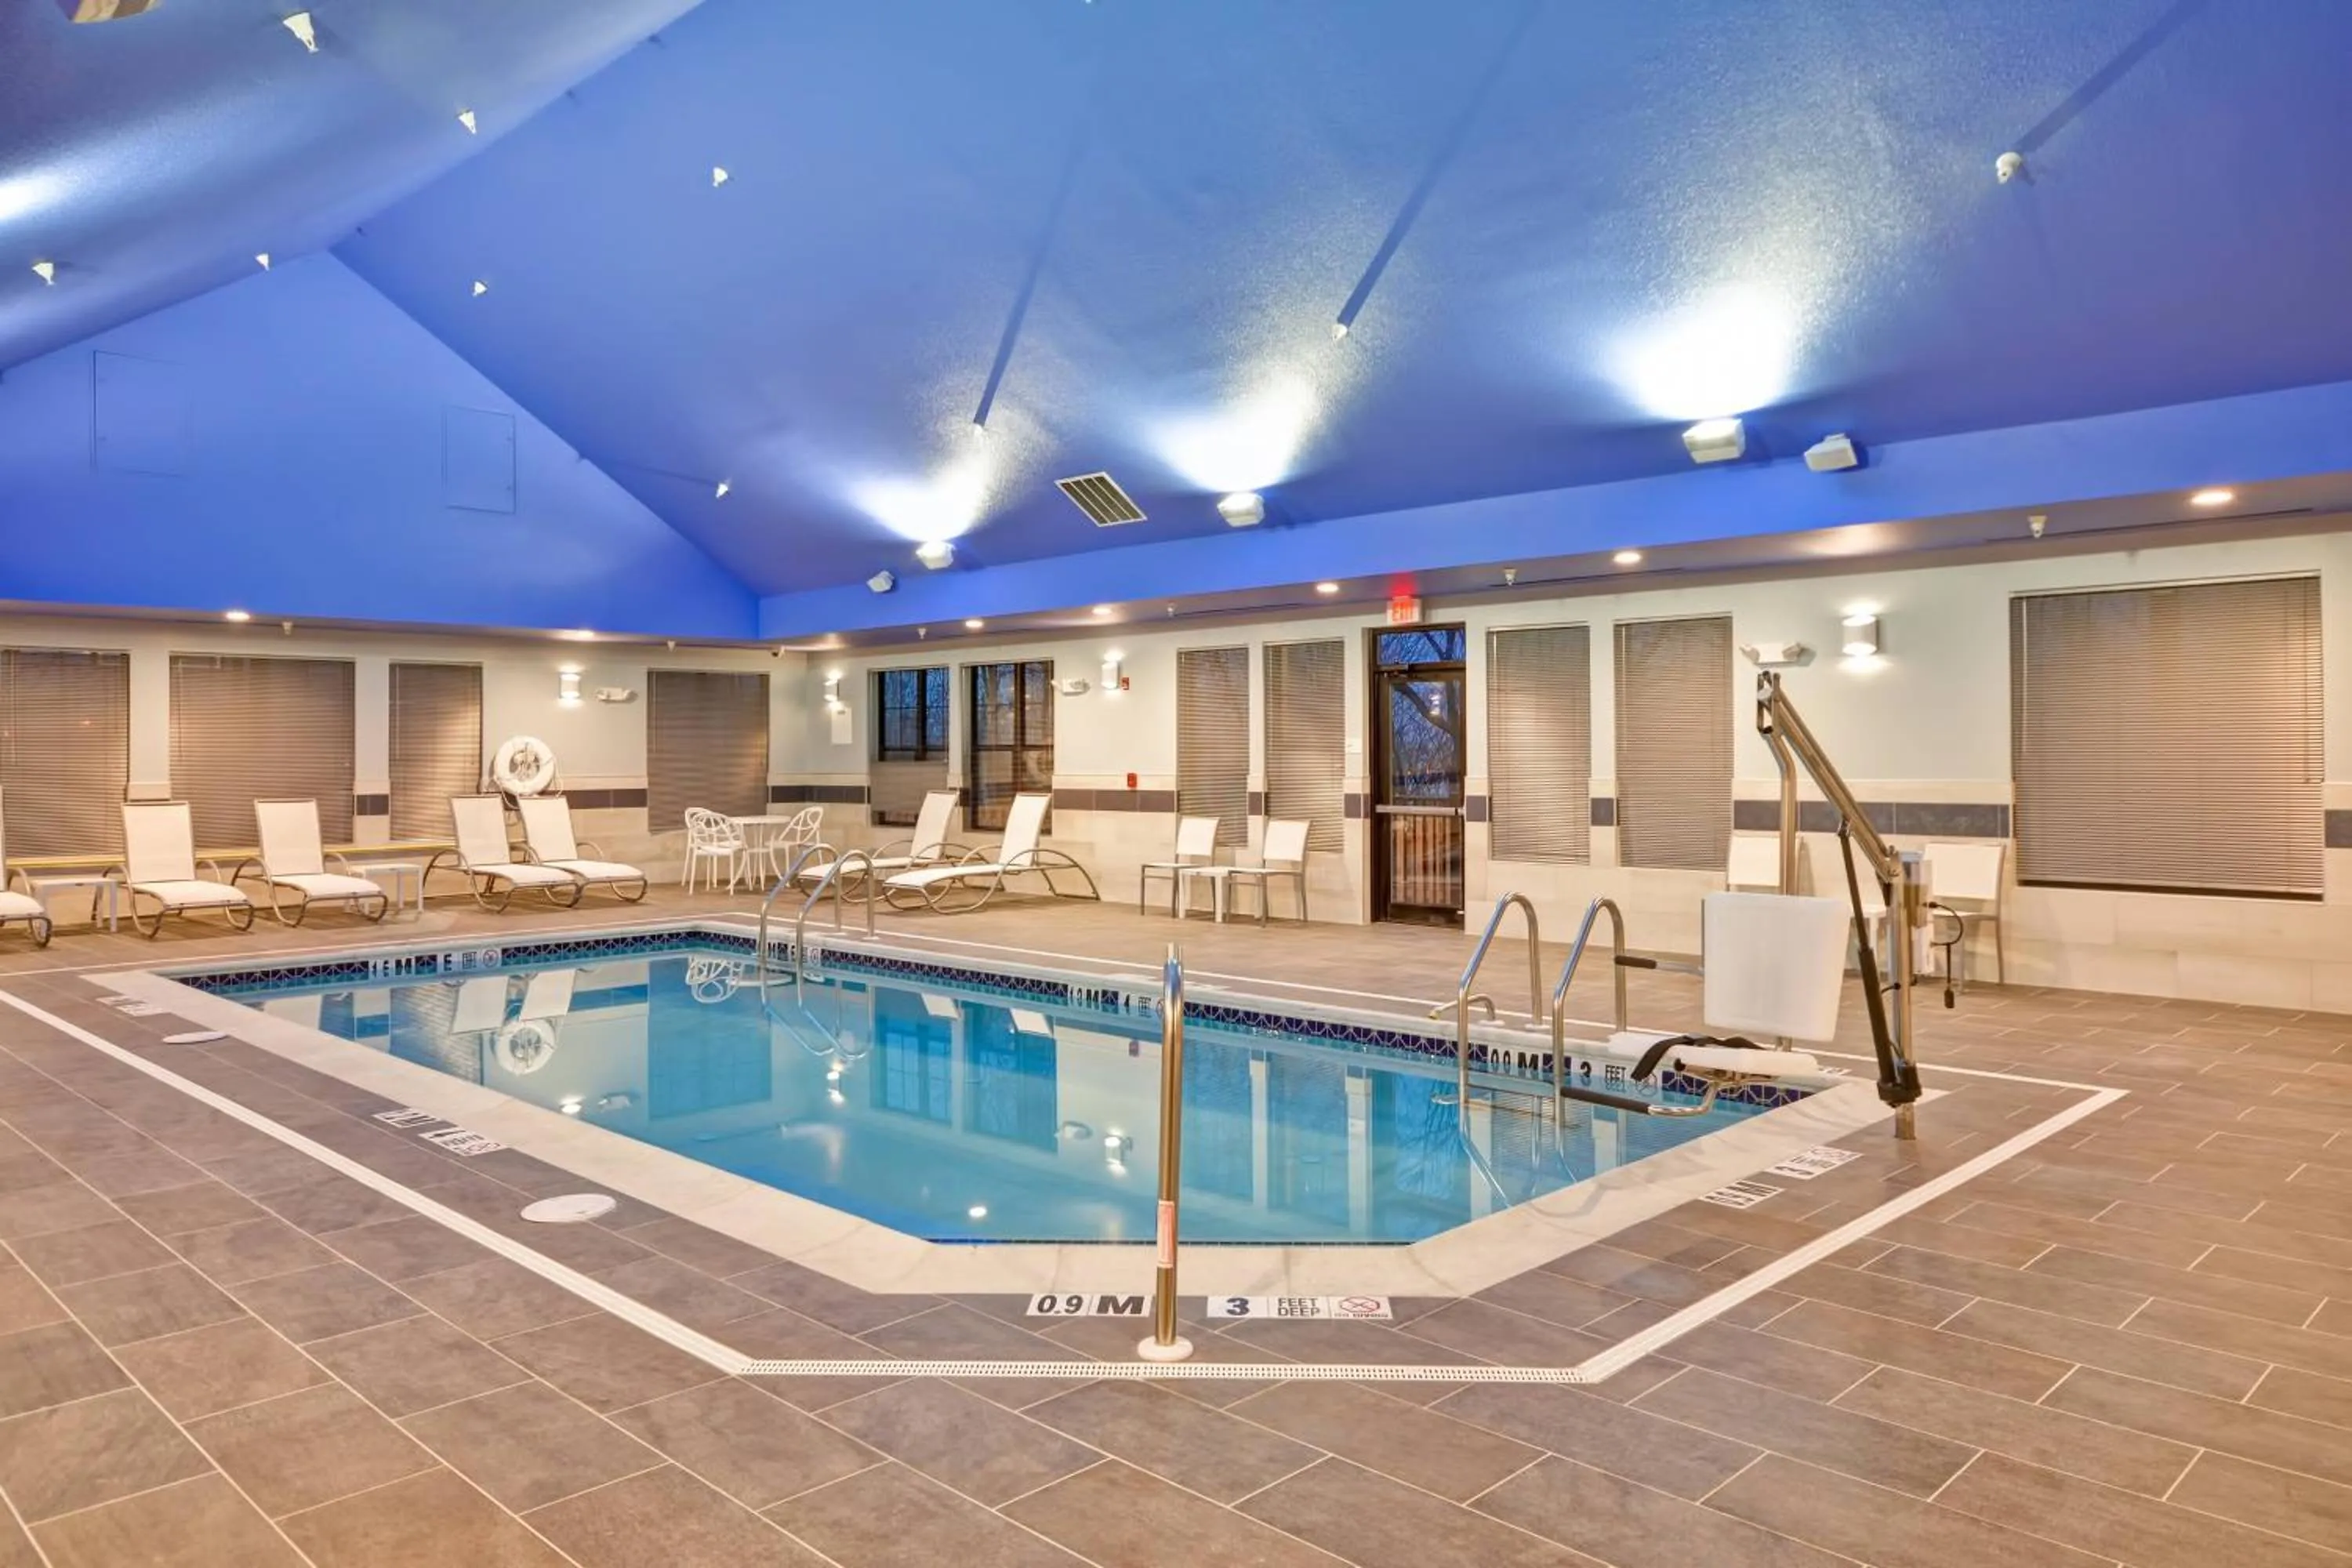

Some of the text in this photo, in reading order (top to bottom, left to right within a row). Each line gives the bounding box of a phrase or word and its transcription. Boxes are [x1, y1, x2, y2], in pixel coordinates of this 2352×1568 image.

[1037, 1294, 1145, 1315] 0.9 M
[1225, 1297, 1250, 1316] 3
[1278, 1298, 1319, 1307] FEET
[1278, 1307, 1321, 1317] DEEP
